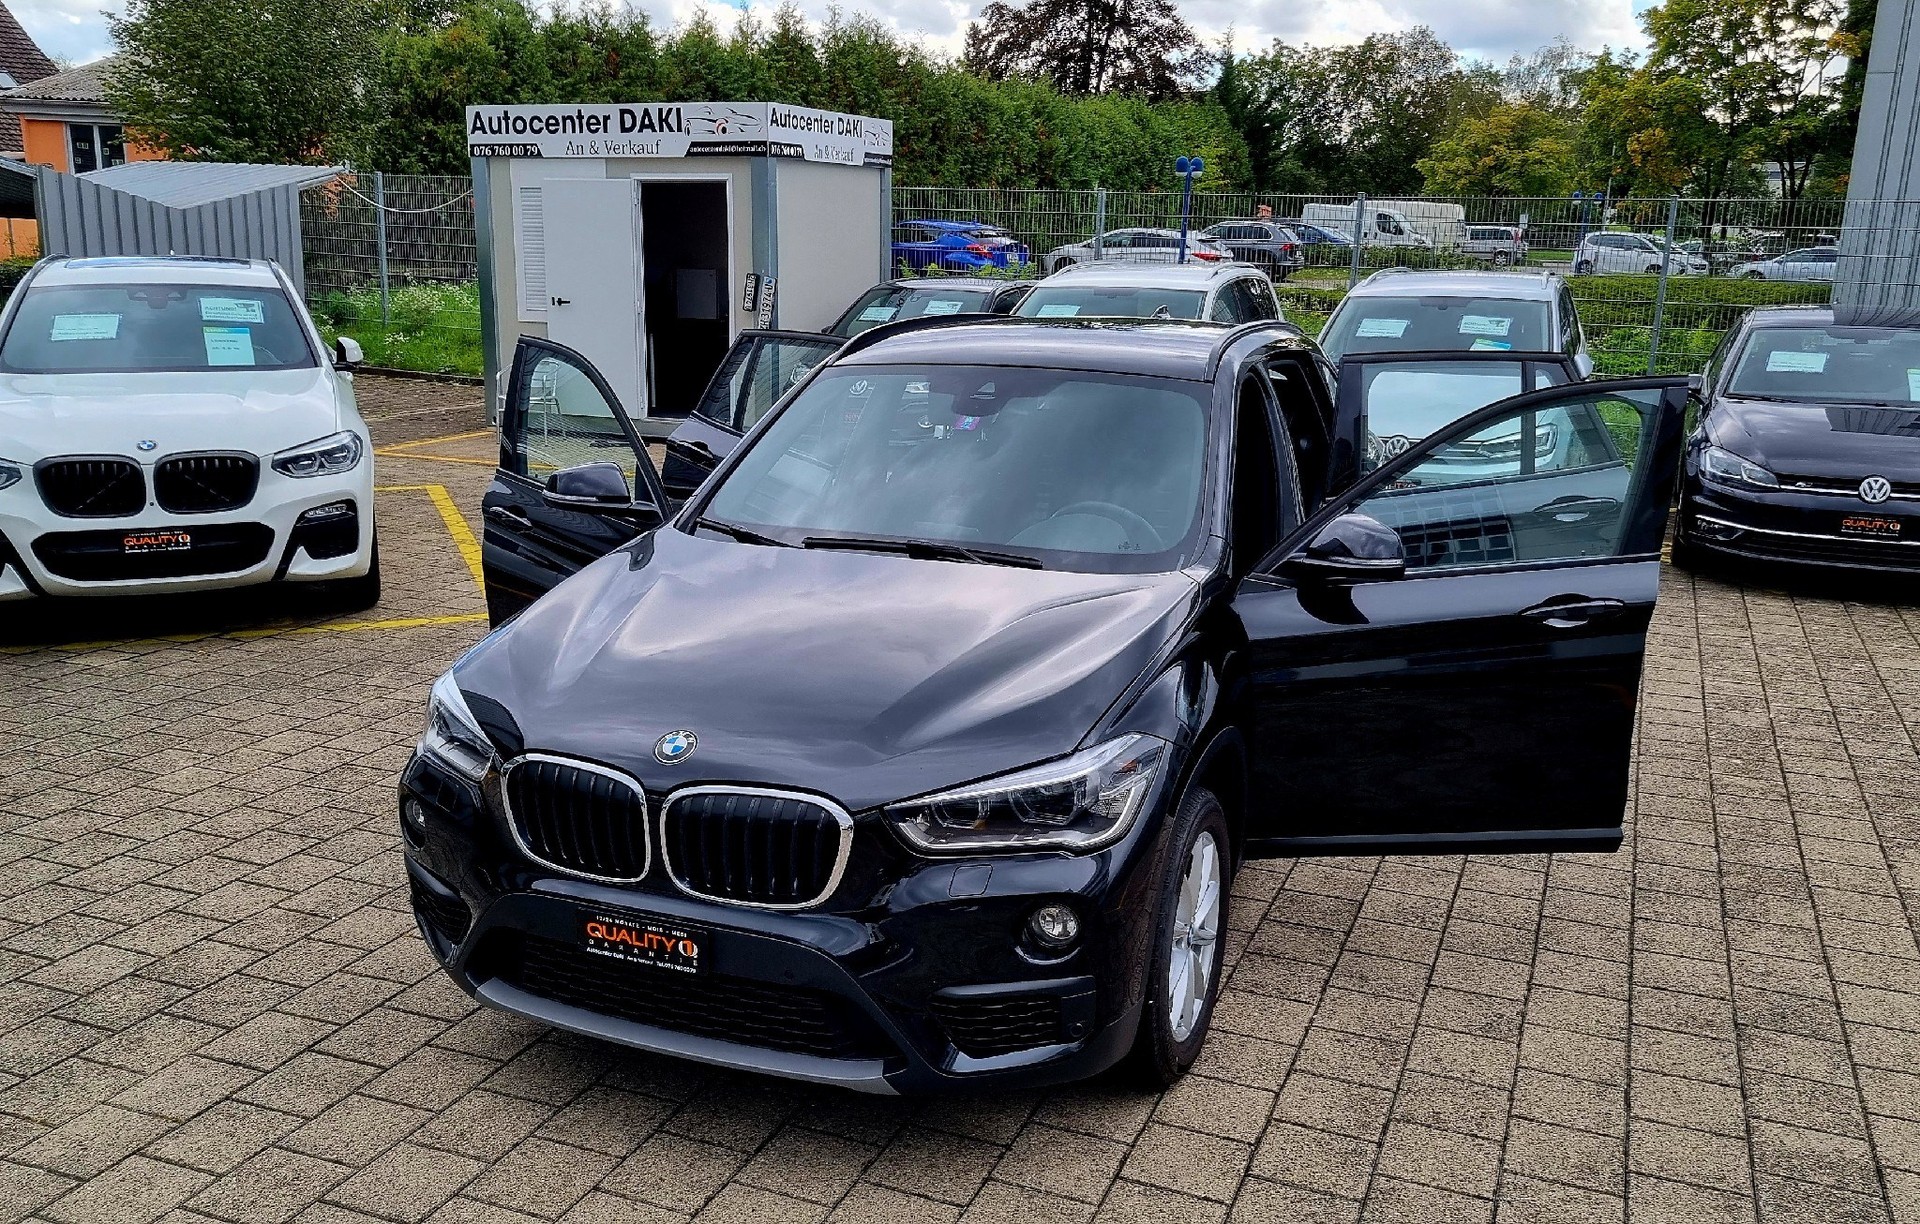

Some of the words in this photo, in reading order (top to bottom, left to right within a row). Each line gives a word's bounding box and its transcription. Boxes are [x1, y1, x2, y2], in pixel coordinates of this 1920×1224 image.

[470, 109, 611, 135] Autocenter
[619, 107, 683, 133] DAKI
[770, 107, 834, 134] Autocenter
[837, 117, 863, 138] DAKI
[474, 146, 491, 156] 076
[493, 145, 511, 156] 760
[512, 145, 525, 156] 00
[526, 145, 538, 155] 79
[565, 141, 585, 155] An
[589, 140, 599, 155] &
[604, 139, 662, 155] Verkauf
[1842, 519, 1890, 530] QUALITY
[124, 535, 177, 546] QUALITY
[587, 922, 676, 952] QUALITY
[588, 938, 698, 966] GARANTIE
